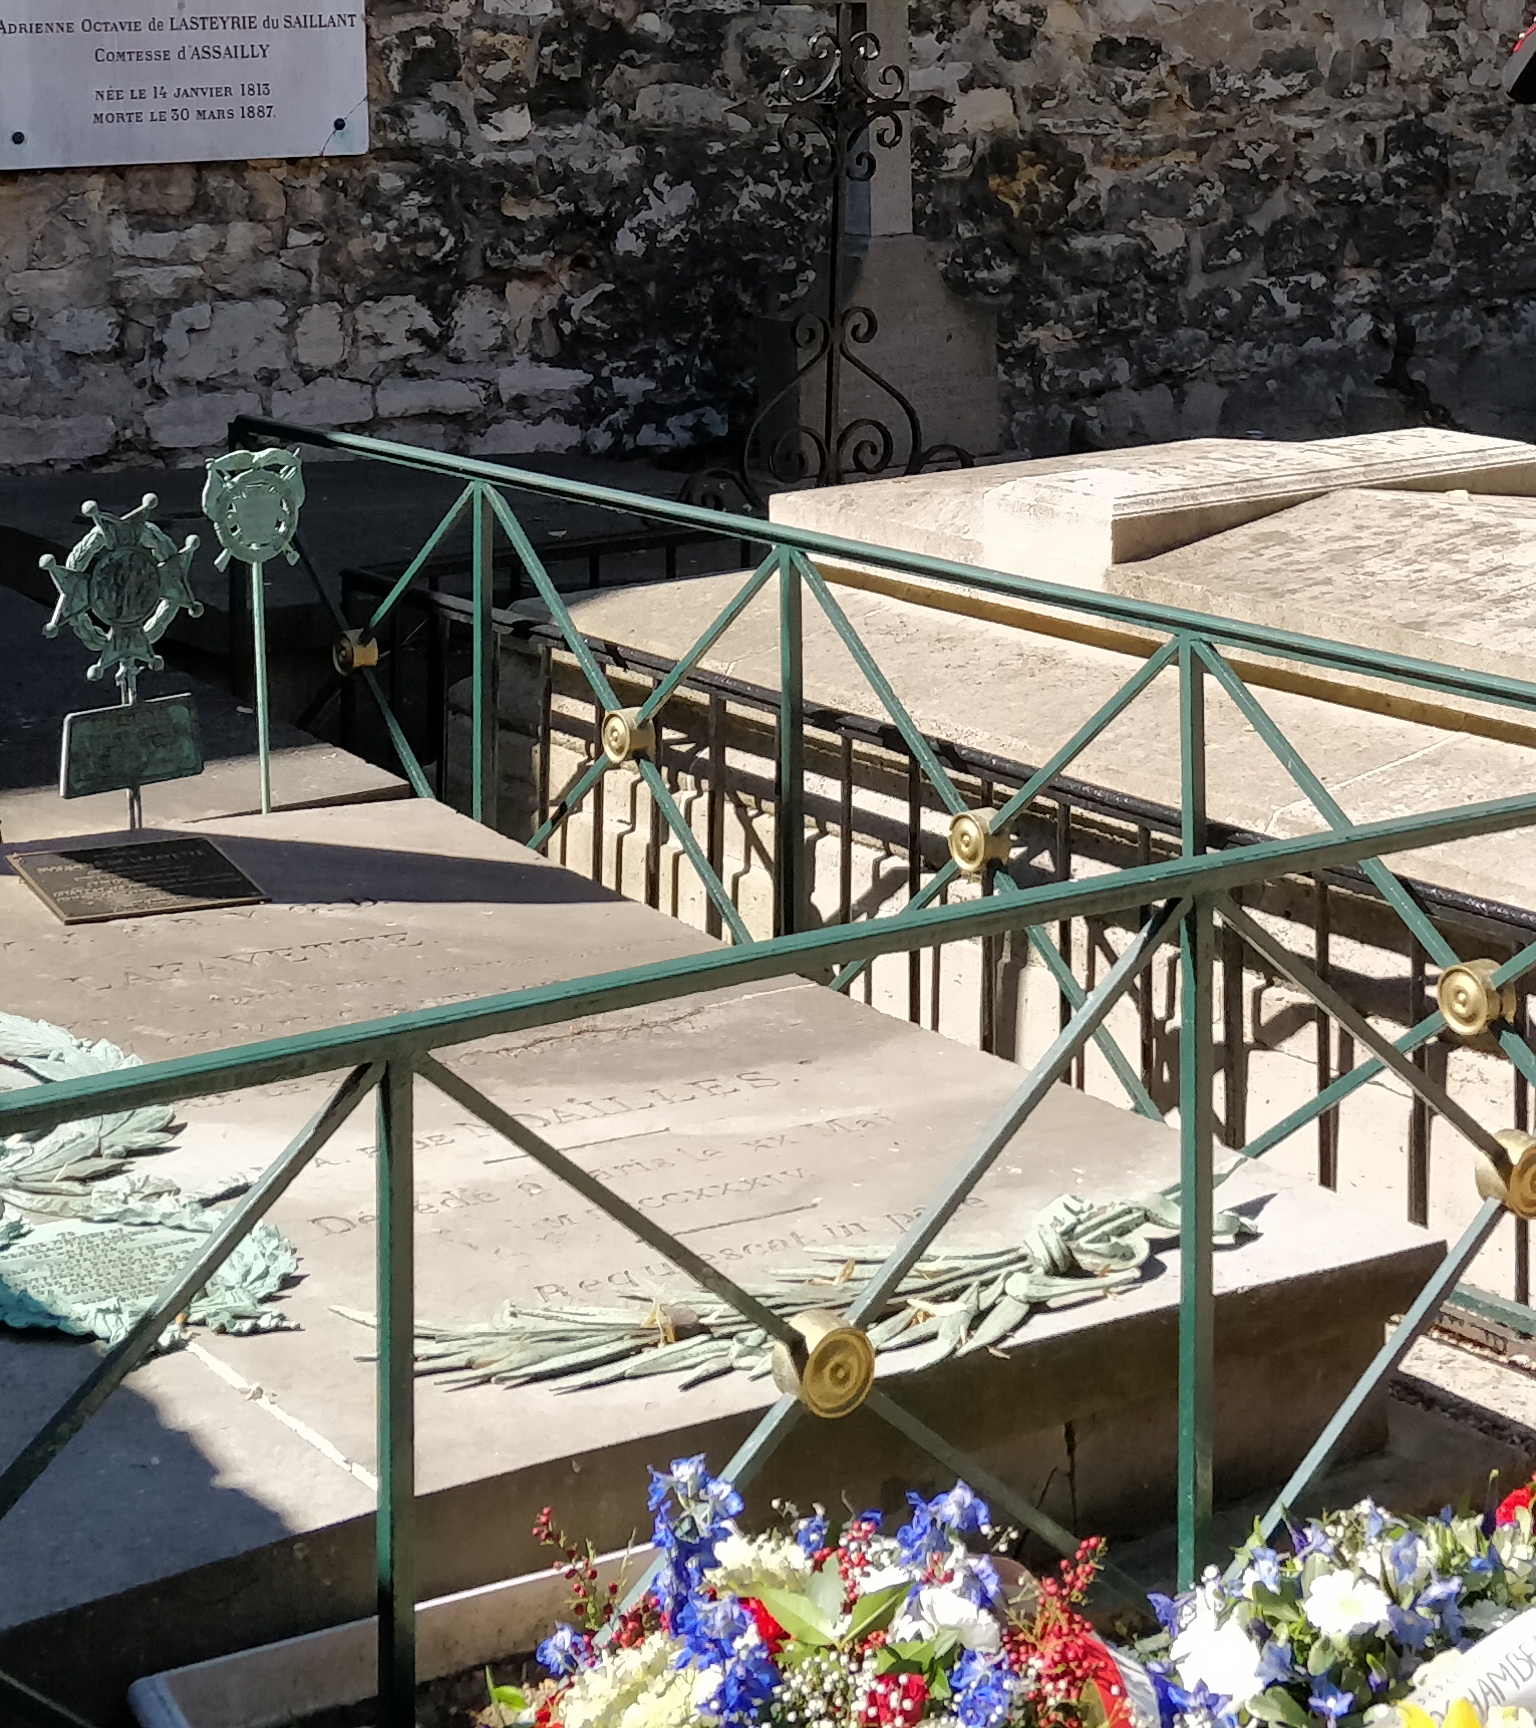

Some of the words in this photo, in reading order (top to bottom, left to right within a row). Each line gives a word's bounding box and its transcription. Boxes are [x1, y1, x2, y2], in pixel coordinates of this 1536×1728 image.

[81, 17, 142, 33] OCTAVIE
[148, 16, 164, 32] de
[169, 15, 258, 32] LASTEYRIE
[262, 14, 279, 30] du
[283, 13, 357, 30] SAILLANT
[94, 47, 172, 63] COMTESSE
[130, 87, 147, 100] LE
[152, 85, 168, 99] 14
[173, 85, 233, 99] JANVIER
[240, 82, 271, 97] 1813
[92, 111, 143, 124] MORTE
[149, 110, 167, 123] LE
[170, 108, 190, 122] 30
[196, 108, 235, 121] MARS
